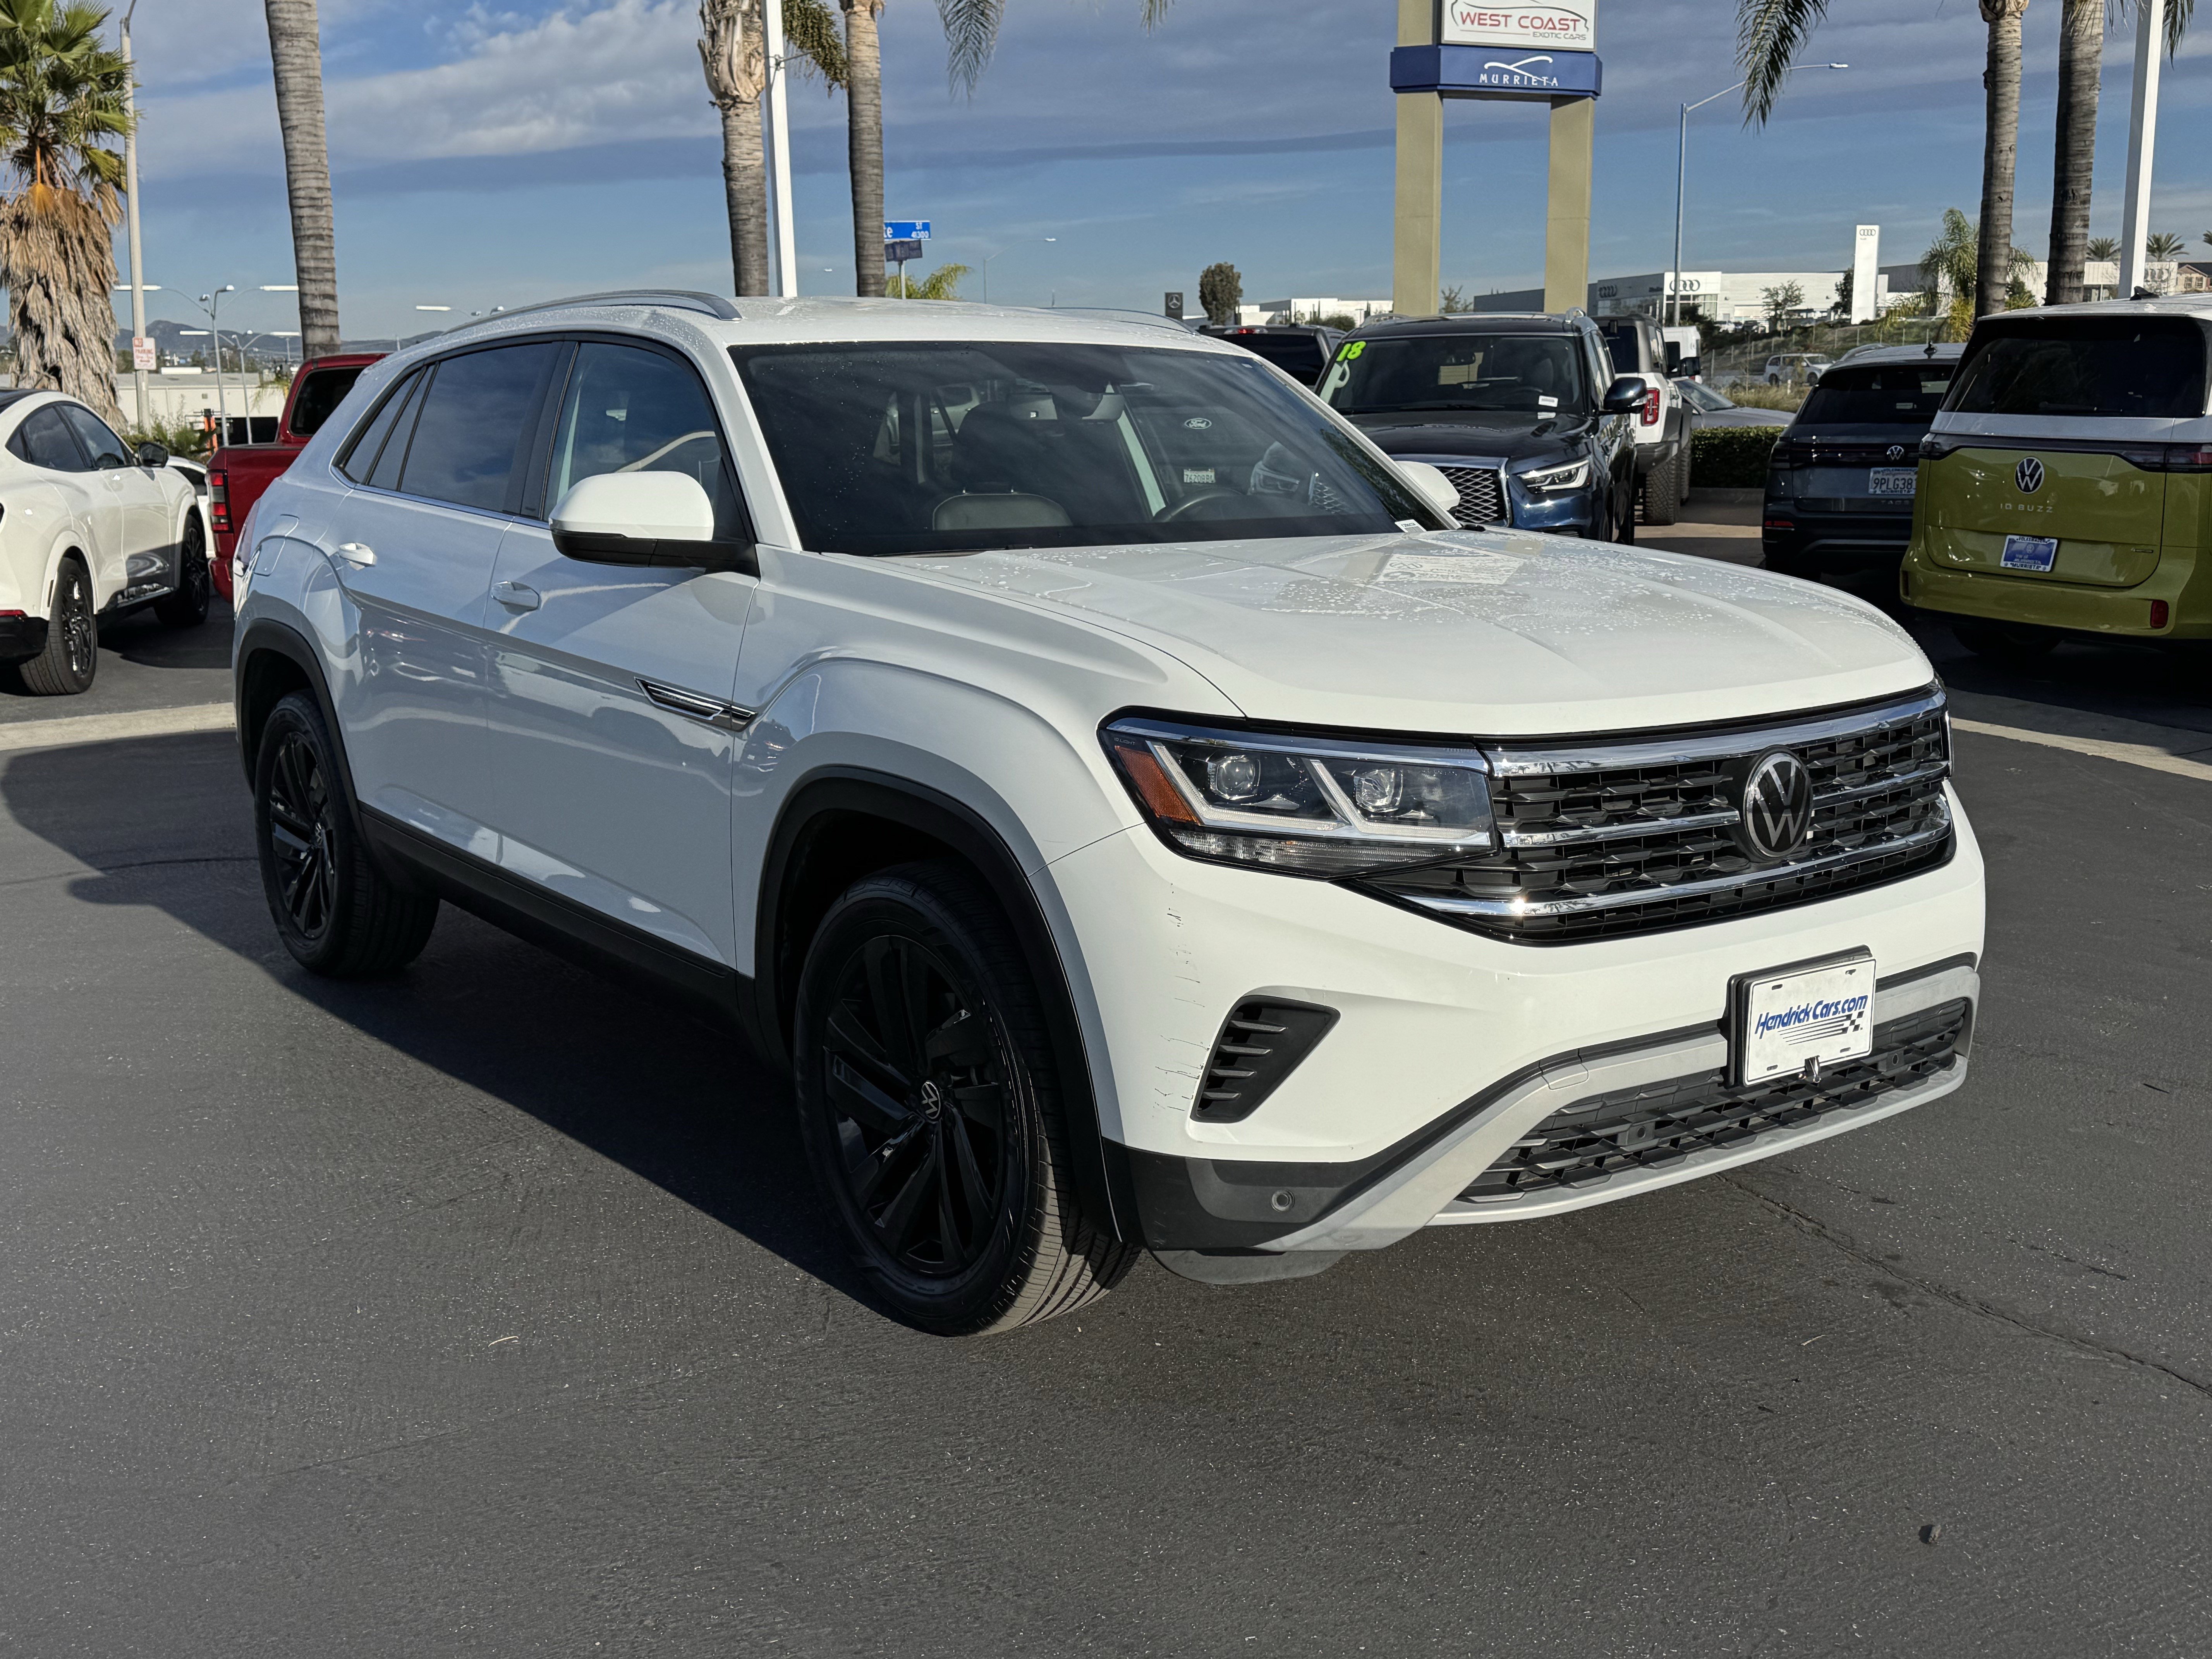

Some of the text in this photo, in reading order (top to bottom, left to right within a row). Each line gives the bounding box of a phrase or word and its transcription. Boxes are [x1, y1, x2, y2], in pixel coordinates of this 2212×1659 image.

[1460, 11, 1581, 32] WEST COAST
[1479, 74, 1558, 86] MURRIETA
[1336, 341, 1366, 361] 18
[1873, 477, 1916, 489] 9PLG38
[2018, 504, 2053, 513] BUZZ
